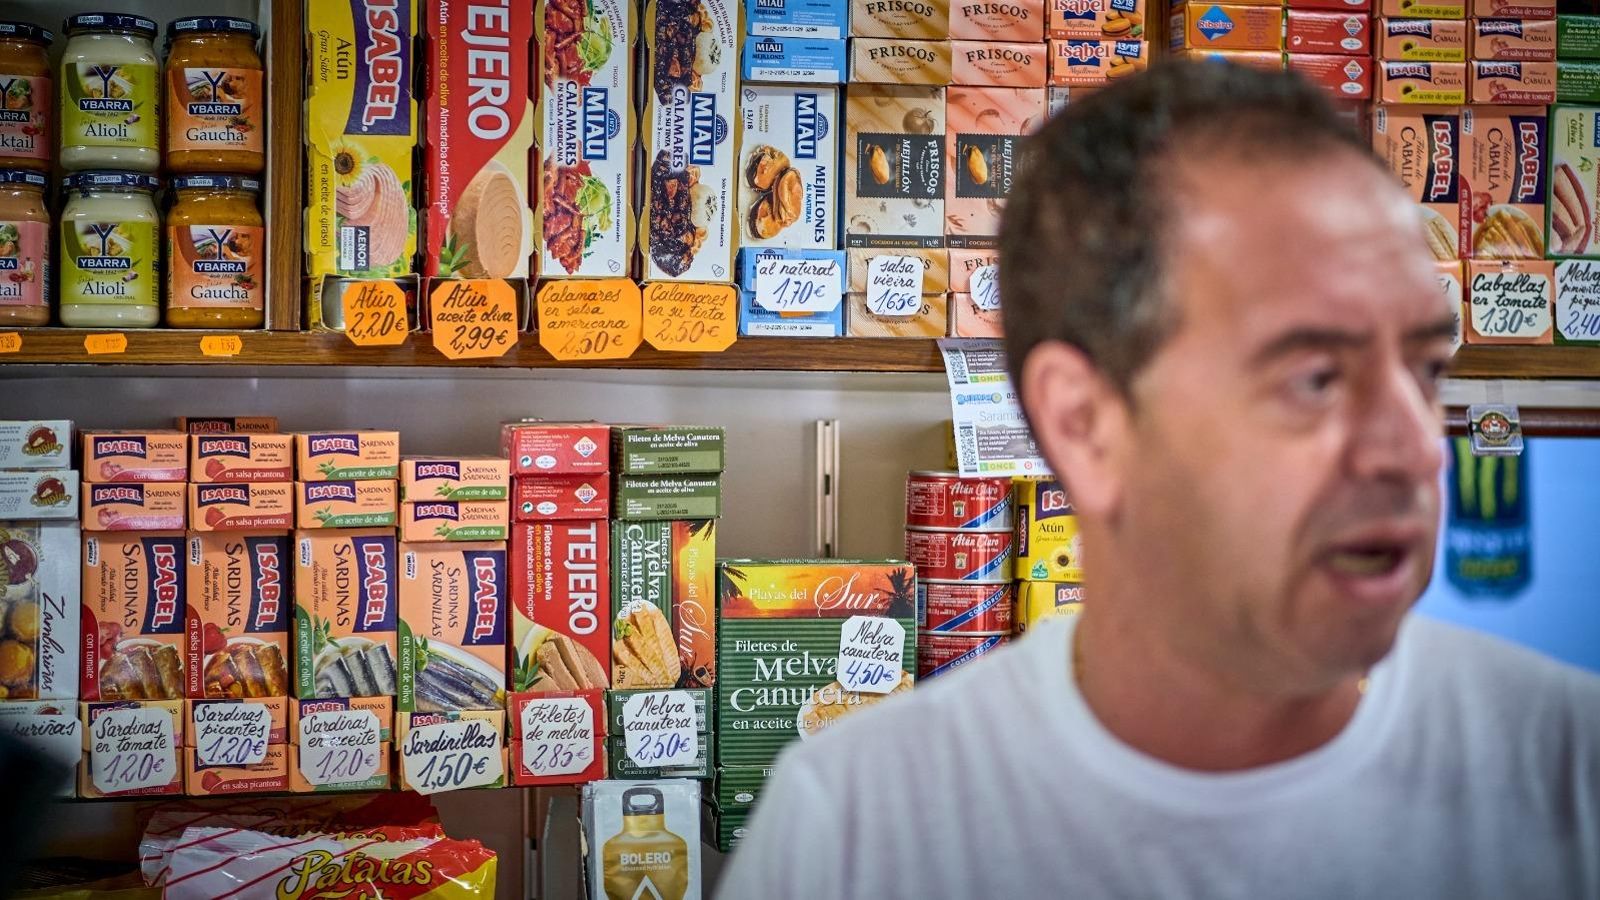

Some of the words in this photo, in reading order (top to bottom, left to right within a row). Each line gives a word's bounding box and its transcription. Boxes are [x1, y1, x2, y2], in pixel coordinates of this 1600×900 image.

[440, 0, 449, 25] Atún
[867, 1, 934, 17] FRISCOS
[962, 3, 1029, 20] FRISCOS
[440, 26, 448, 37] en
[336, 37, 353, 80] Atún
[440, 38, 448, 69] aceite
[869, 45, 937, 61] FRISCOS
[966, 48, 1032, 65] FRISCOS
[1058, 43, 1110, 61] Isabel
[361, 0, 402, 127] ISABEL
[461, 0, 511, 140] EJERO
[1390, 64, 1430, 78] ISABEL
[440, 70, 448, 82] de
[440, 83, 448, 106] oliva
[557, 83, 564, 93] EN
[82, 101, 131, 110] YBARRA
[191, 105, 239, 115] YBARRA
[84, 122, 127, 139] Alioli
[440, 107, 448, 159] Almadraba
[565, 81, 578, 166] CALAMARES
[585, 90, 605, 155] MIAU
[672, 88, 686, 168] CALAMARES
[692, 96, 713, 162] MIAU
[798, 95, 816, 155] MIAU
[186, 127, 245, 143] Gaucha
[556, 119, 564, 162] AMERICANA
[440, 159, 448, 176] del
[901, 139, 911, 193] MEJILLÓN
[926, 140, 938, 195] FRISCOS
[1400, 126, 1416, 189] CABALLA
[1430, 122, 1453, 198] ISABEL
[1487, 128, 1503, 190] CABALLA
[1518, 122, 1539, 199] ISABEL
[320, 163, 328, 175] en
[320, 176, 331, 203] aceite
[806, 182, 812, 192] AL
[321, 204, 331, 219] de
[814, 165, 826, 243] MEJILLONES
[319, 220, 331, 247] girasol
[357, 228, 367, 268] AENOR
[80, 258, 129, 269] YBARRA
[196, 262, 244, 272] YBARRA
[759, 261, 774, 276] al
[780, 258, 836, 277] natural
[880, 256, 914, 273] salsa
[82, 280, 125, 296] Alioli
[873, 274, 916, 288] vieira
[1472, 273, 1546, 293] Caballas
[190, 284, 249, 300] Gaucha
[351, 285, 397, 309] Atún
[443, 284, 488, 308] Atún
[543, 286, 622, 303] Calamares
[650, 284, 729, 306] Calamares
[1472, 295, 1489, 306] en
[1496, 294, 1547, 310] tomate
[436, 309, 476, 323] aceite
[480, 304, 513, 323] oliva
[544, 306, 559, 316] en
[567, 303, 604, 315] salsa
[649, 306, 664, 317] en
[668, 307, 685, 318] su
[690, 304, 727, 321] tinta
[547, 320, 629, 330] americana
[1564, 310, 1600, 338] 2,40
[202, 439, 248, 453] ISABEL
[251, 441, 286, 450] SARDINAS
[311, 438, 358, 451] ISABEL
[360, 439, 395, 448] SARDINAS
[683, 479, 717, 487] Canutera
[949, 481, 974, 496] Atún
[975, 481, 998, 496] Claro
[202, 488, 248, 501] ISABEL
[250, 488, 286, 497] SARDINAS
[460, 513, 500, 521] SARDINILLAS
[1039, 522, 1064, 533] Atún
[544, 525, 553, 556] Filetes
[951, 534, 975, 547] Atún
[977, 533, 999, 547] Claro
[544, 558, 553, 570] de
[626, 524, 645, 614] Canutera
[122, 543, 141, 628] SARDINAS
[152, 544, 178, 627] ISABEL
[225, 542, 243, 627] SARDINAS
[255, 543, 280, 627] ISABEL
[333, 543, 351, 627] SARDINAS
[363, 543, 386, 627] ISABEL
[544, 573, 553, 600] Melva
[563, 522, 598, 635] TEJERO
[430, 559, 444, 638] SARDINILLAS
[750, 588, 786, 606] Playas
[790, 588, 807, 600] del
[814, 572, 880, 617] Sur
[968, 590, 1004, 617] CONSORCIO
[192, 618, 199, 628] en
[850, 620, 895, 646] Melva
[42, 592, 66, 692] Zamburiñas
[190, 629, 198, 650] salsa
[402, 636, 411, 646] en
[735, 640, 777, 652] Filetes
[782, 639, 798, 652] de
[402, 647, 412, 672] aceite
[841, 643, 900, 662] canutera
[950, 642, 991, 668] CONSORCIO
[86, 651, 94, 679] tomate
[190, 652, 199, 692] picantona
[752, 651, 839, 682] Melva
[402, 673, 412, 683] de
[402, 684, 412, 704] oliva
[196, 704, 263, 723] Sardinas
[528, 703, 586, 724] Filetes
[635, 694, 686, 717] Melva
[95, 716, 162, 739] Sardinas
[201, 724, 266, 740] picantes
[304, 714, 369, 735] Sardinas
[525, 728, 543, 741] de
[547, 723, 590, 740] melva
[625, 713, 692, 732] canutera
[95, 741, 110, 753] en
[117, 733, 168, 751] tomate
[308, 736, 323, 748] en
[404, 722, 498, 757] Sardinillas
[620, 852, 672, 865] BOLERO
[276, 850, 434, 900] Patatas
